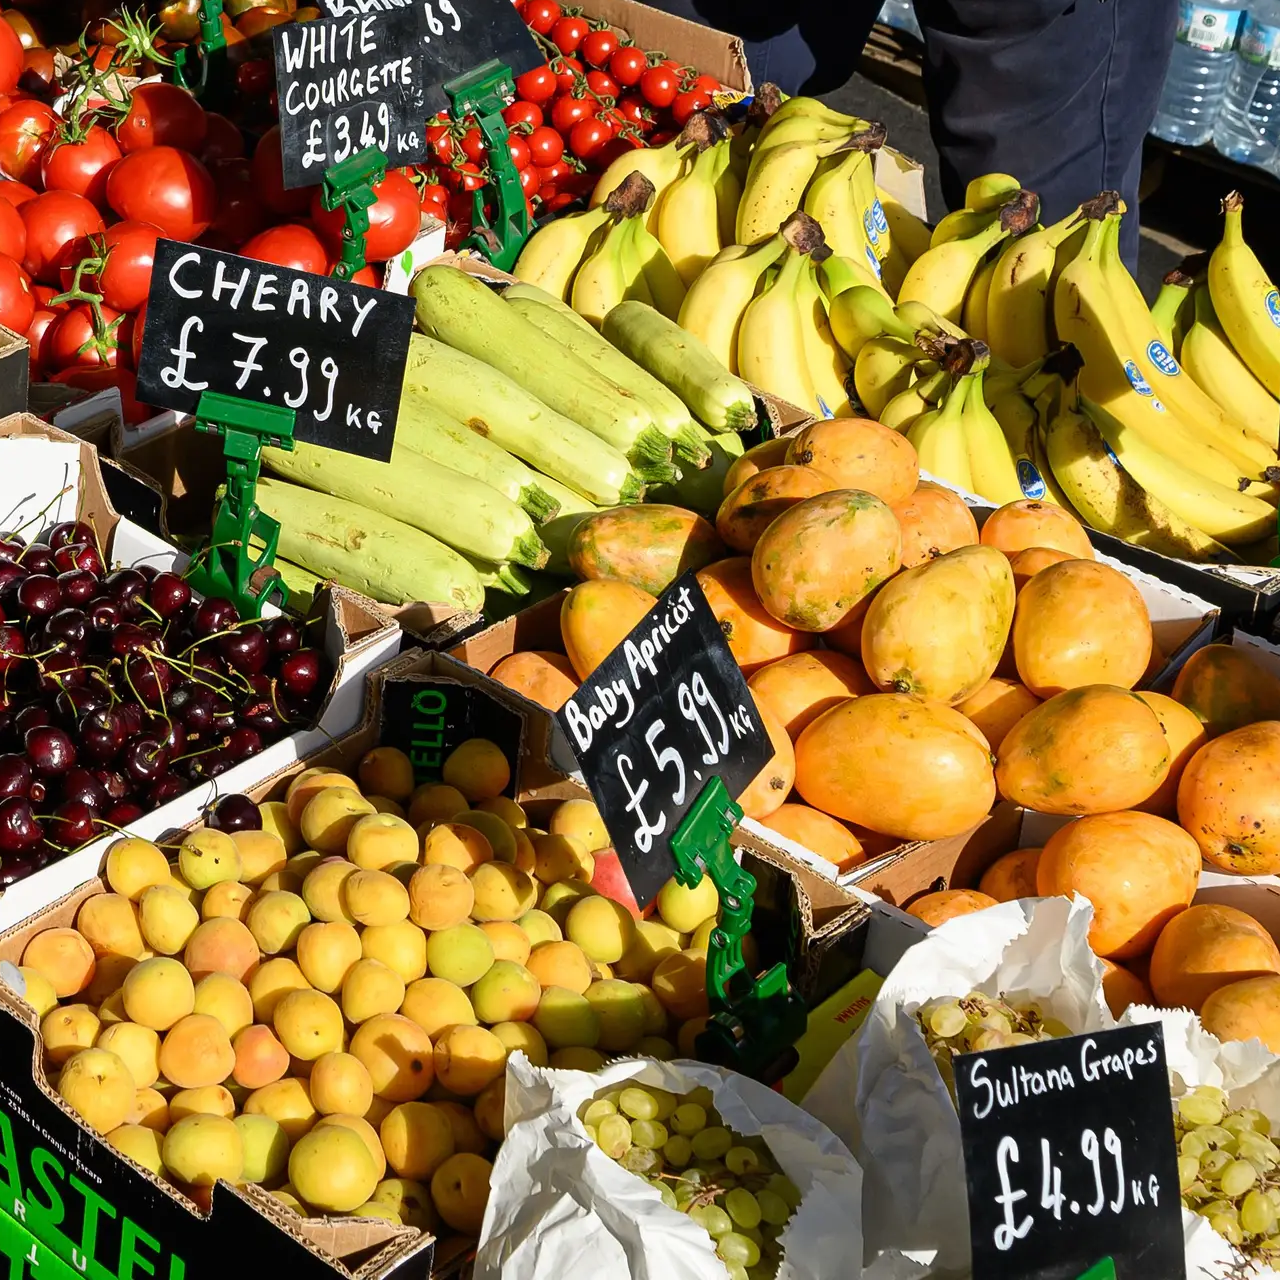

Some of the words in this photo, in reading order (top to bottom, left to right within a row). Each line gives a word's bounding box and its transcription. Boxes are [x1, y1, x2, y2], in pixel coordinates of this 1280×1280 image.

[281, 14, 378, 74] WHITE
[285, 56, 414, 116] COURGETTE
[301, 101, 391, 170] £3.49
[396, 131, 420, 154] KG
[168, 251, 378, 338] CHERRY
[159, 314, 340, 422] £7.99
[345, 403, 383, 435] KG
[563, 678, 636, 753] Baby
[615, 670, 731, 854] £5.99
[728, 704, 756, 740] KG
[969, 1056, 1075, 1121] Sultana
[1080, 1038, 1158, 1084] Grapes
[7, 1098, 31, 1123] 25185
[41, 1128, 68, 1157] Granja
[993, 1127, 1127, 1252] £4.99
[1131, 1173, 1160, 1207] KG
